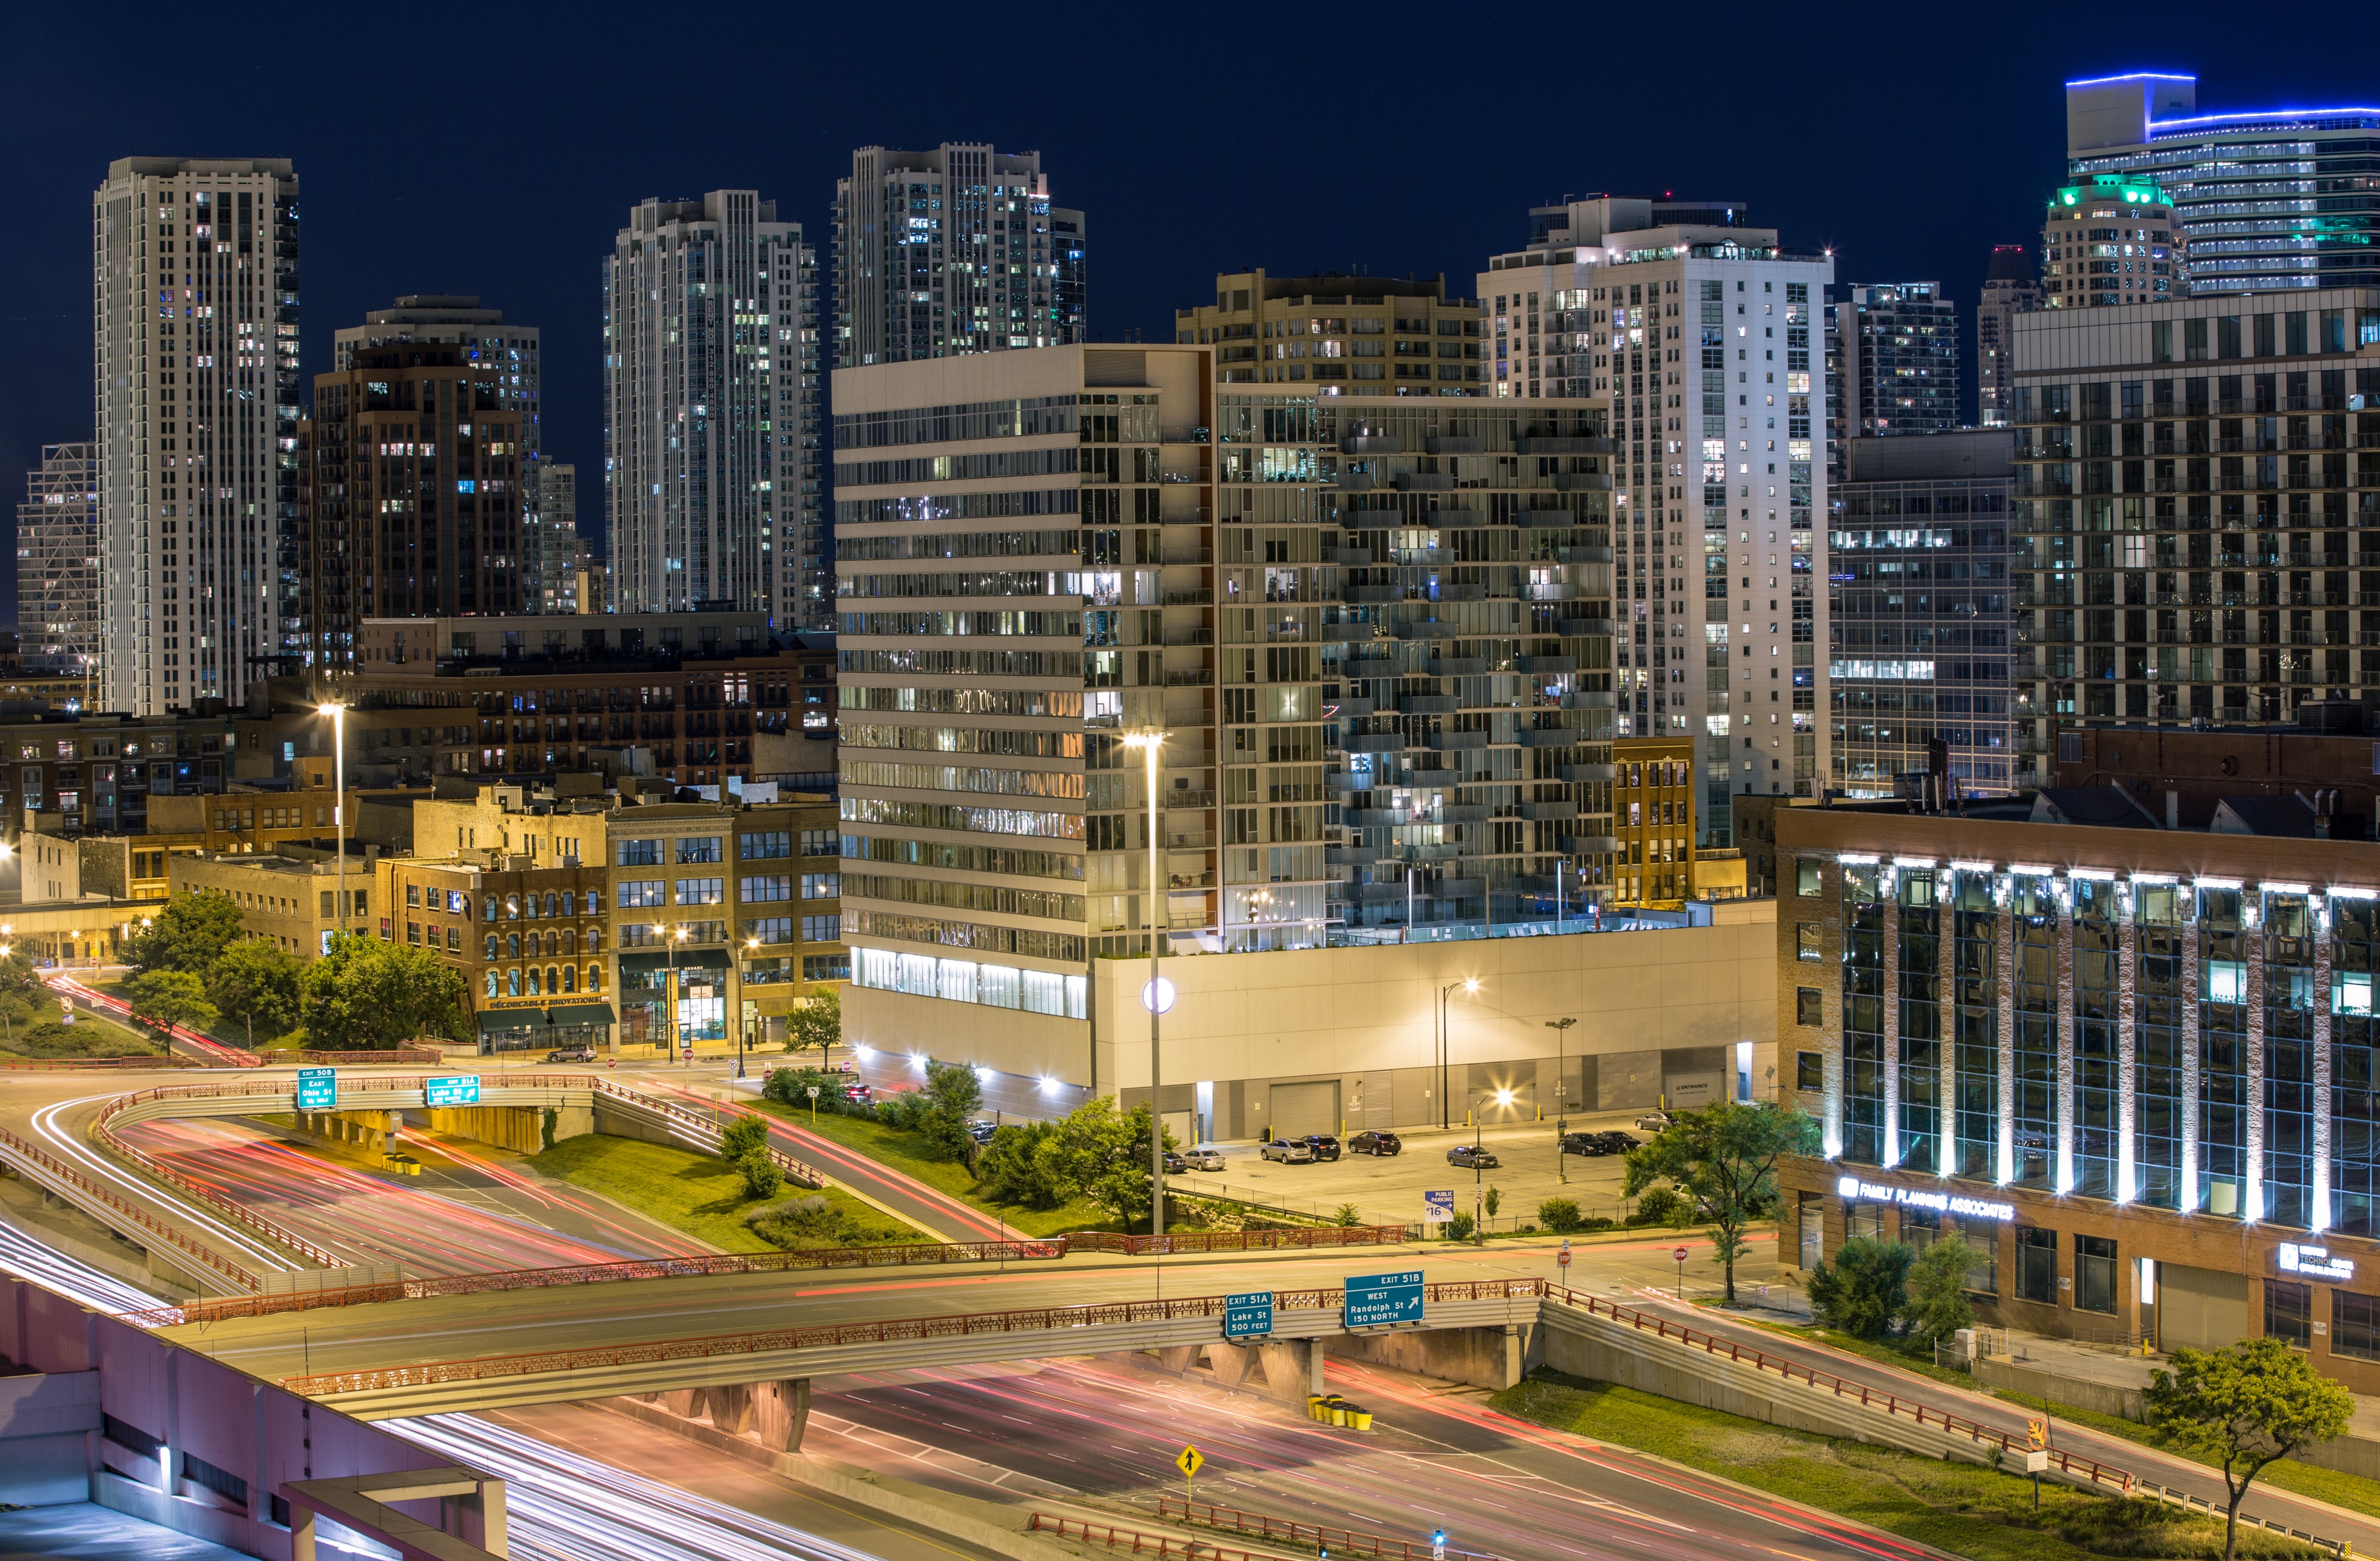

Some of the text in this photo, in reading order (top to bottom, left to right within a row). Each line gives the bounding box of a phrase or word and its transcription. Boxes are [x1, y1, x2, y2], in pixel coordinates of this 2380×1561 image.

[549, 996, 600, 1006] INNOVATIONS
[1860, 1183, 1894, 1200] FAMILY
[1949, 1197, 2013, 1221] ASSOCIATES
[1426, 1207, 1441, 1216] $16
[1402, 1274, 1420, 1282] 51B
[1229, 1294, 1268, 1305] EXIT 51A
[1351, 1303, 1390, 1313] Randolph
[1232, 1313, 1252, 1321] Lake
[1371, 1312, 1398, 1321] NORTH
[1232, 1323, 1248, 1331] 500
